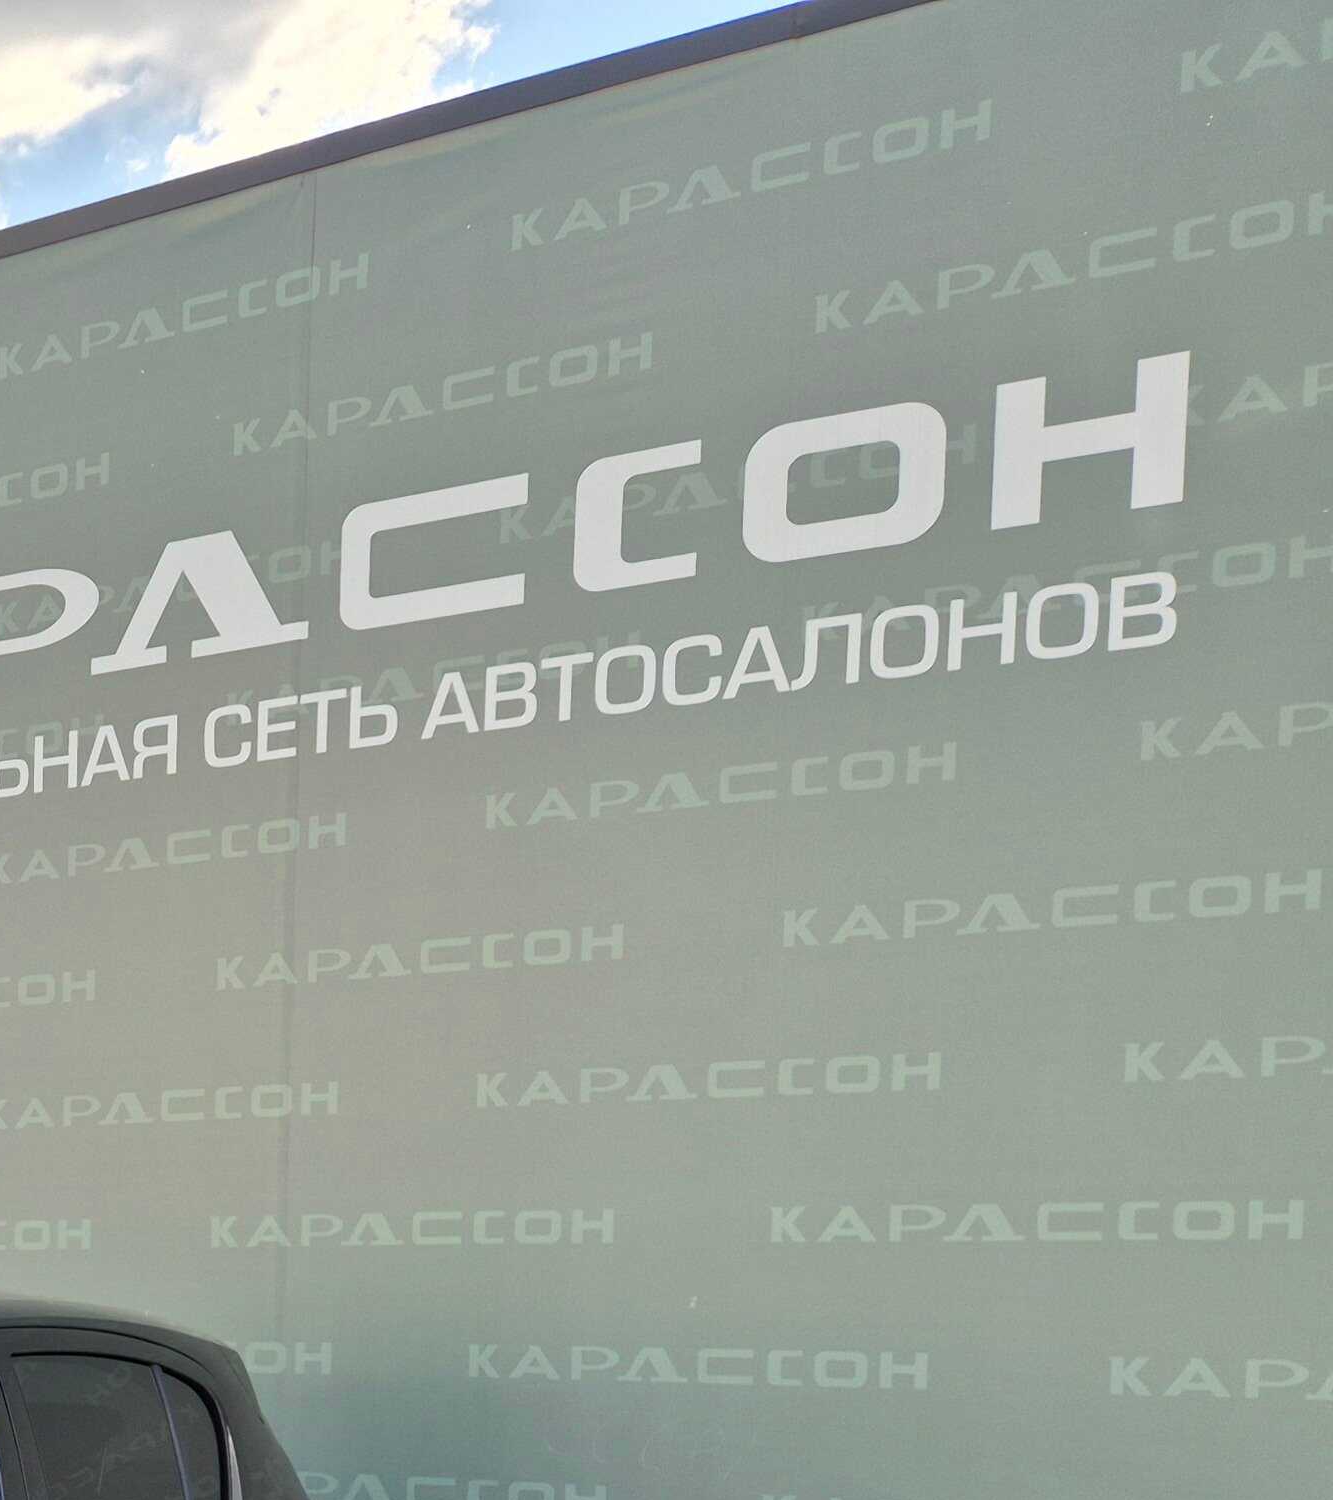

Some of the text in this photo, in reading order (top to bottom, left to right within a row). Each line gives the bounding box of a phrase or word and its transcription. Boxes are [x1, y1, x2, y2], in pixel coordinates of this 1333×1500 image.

[1180, 17, 1333, 93] КА
[512, 98, 993, 253] КАРАССОН
[0, 253, 369, 381] КАРАССОН
[232, 332, 654, 456] КАРАССОН
[203, 686, 399, 768] СЕТЬ
[421, 571, 1178, 740] АВТОСАЛОНОВ
[485, 741, 958, 830] КАРАССОН
[783, 868, 1322, 947] КАРАССОН
[216, 923, 625, 990] КАРАССОН
[476, 1051, 942, 1109] КАРАССОН
[210, 1208, 615, 1249] КАРАССОН
[769, 1199, 1305, 1246] КАРАССОН
[468, 1344, 929, 1390] КАРАССОН
